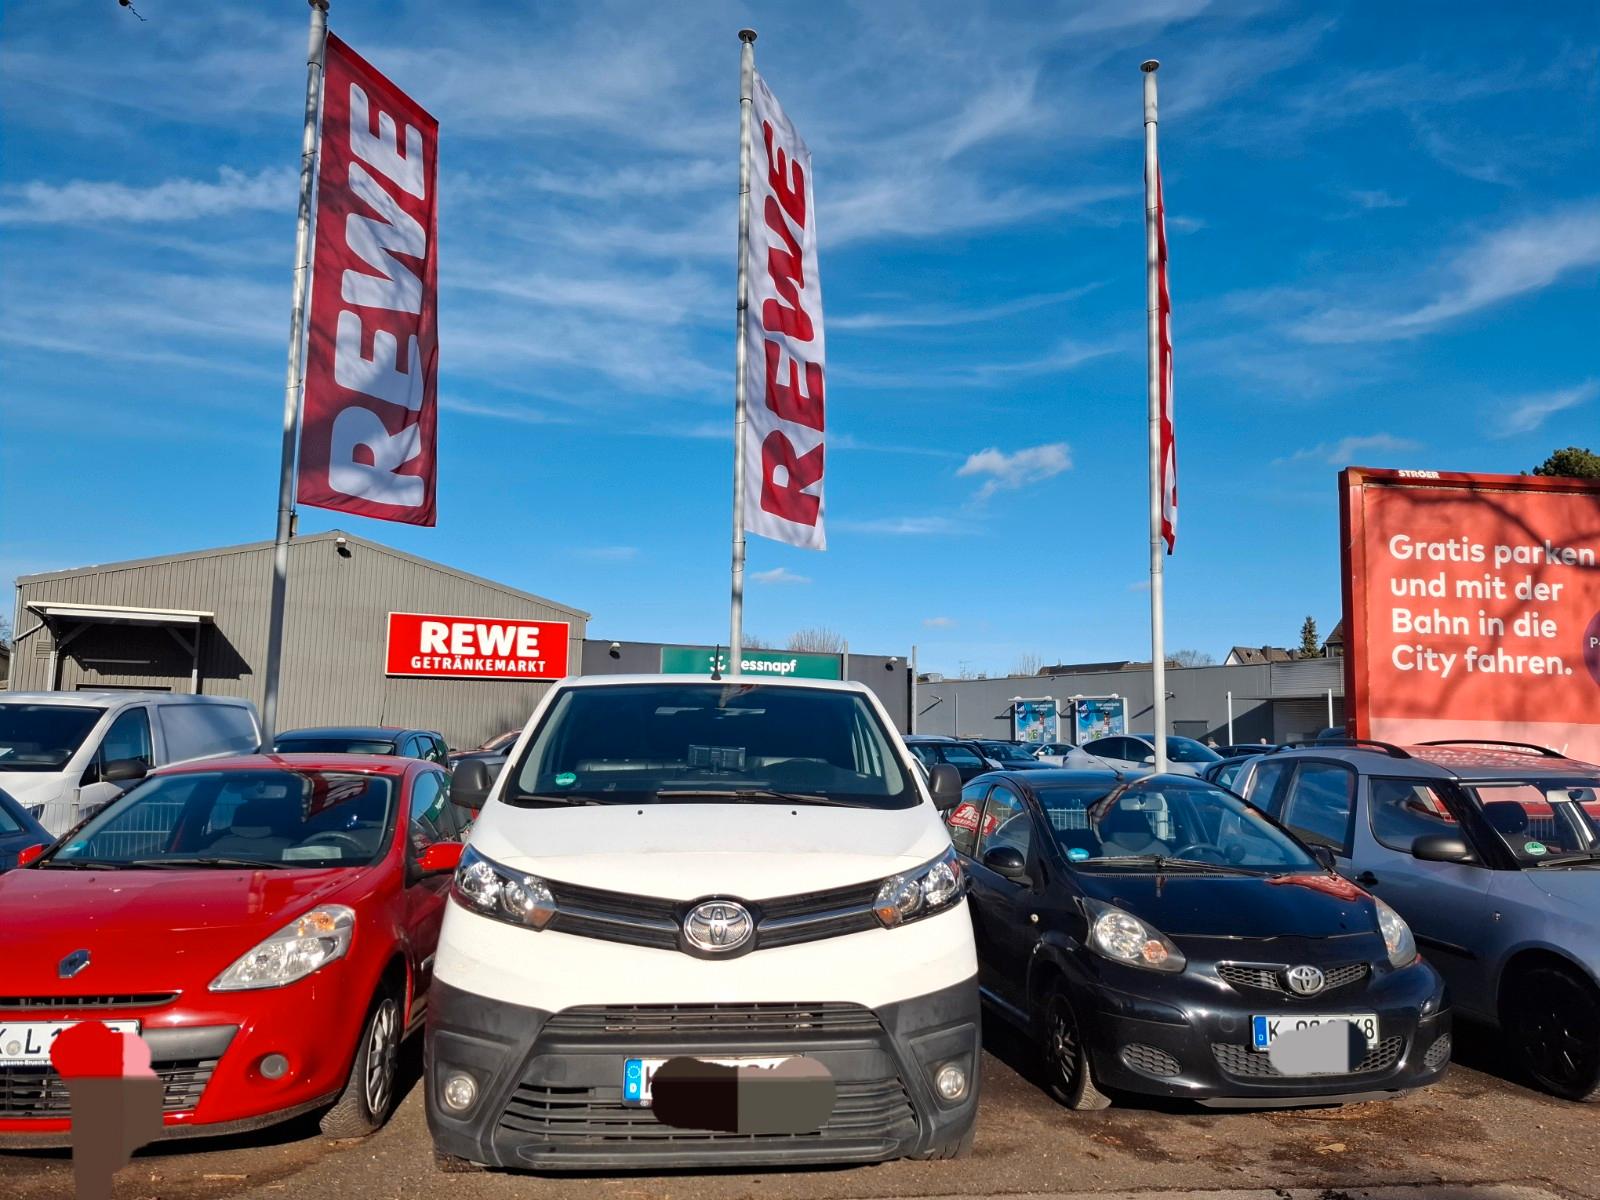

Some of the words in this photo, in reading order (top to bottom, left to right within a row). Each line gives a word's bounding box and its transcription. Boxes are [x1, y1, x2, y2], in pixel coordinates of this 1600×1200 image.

[328, 82, 426, 507] REWE
[760, 120, 825, 527] REWE
[1389, 534, 1486, 562] Gratis
[1494, 539, 1596, 569] parken
[1390, 571, 1446, 597] und
[1456, 573, 1507, 599] mit
[1514, 575, 1563, 601] der
[420, 621, 540, 658] REWE
[1392, 608, 1470, 636] Bahn
[1478, 610, 1504, 636] in
[1513, 611, 1557, 638] die
[411, 655, 546, 673] GETRÄNKEMARKT
[739, 659, 797, 675] essnapf
[1391, 644, 1456, 678] City
[1464, 646, 1573, 676] fahren.
